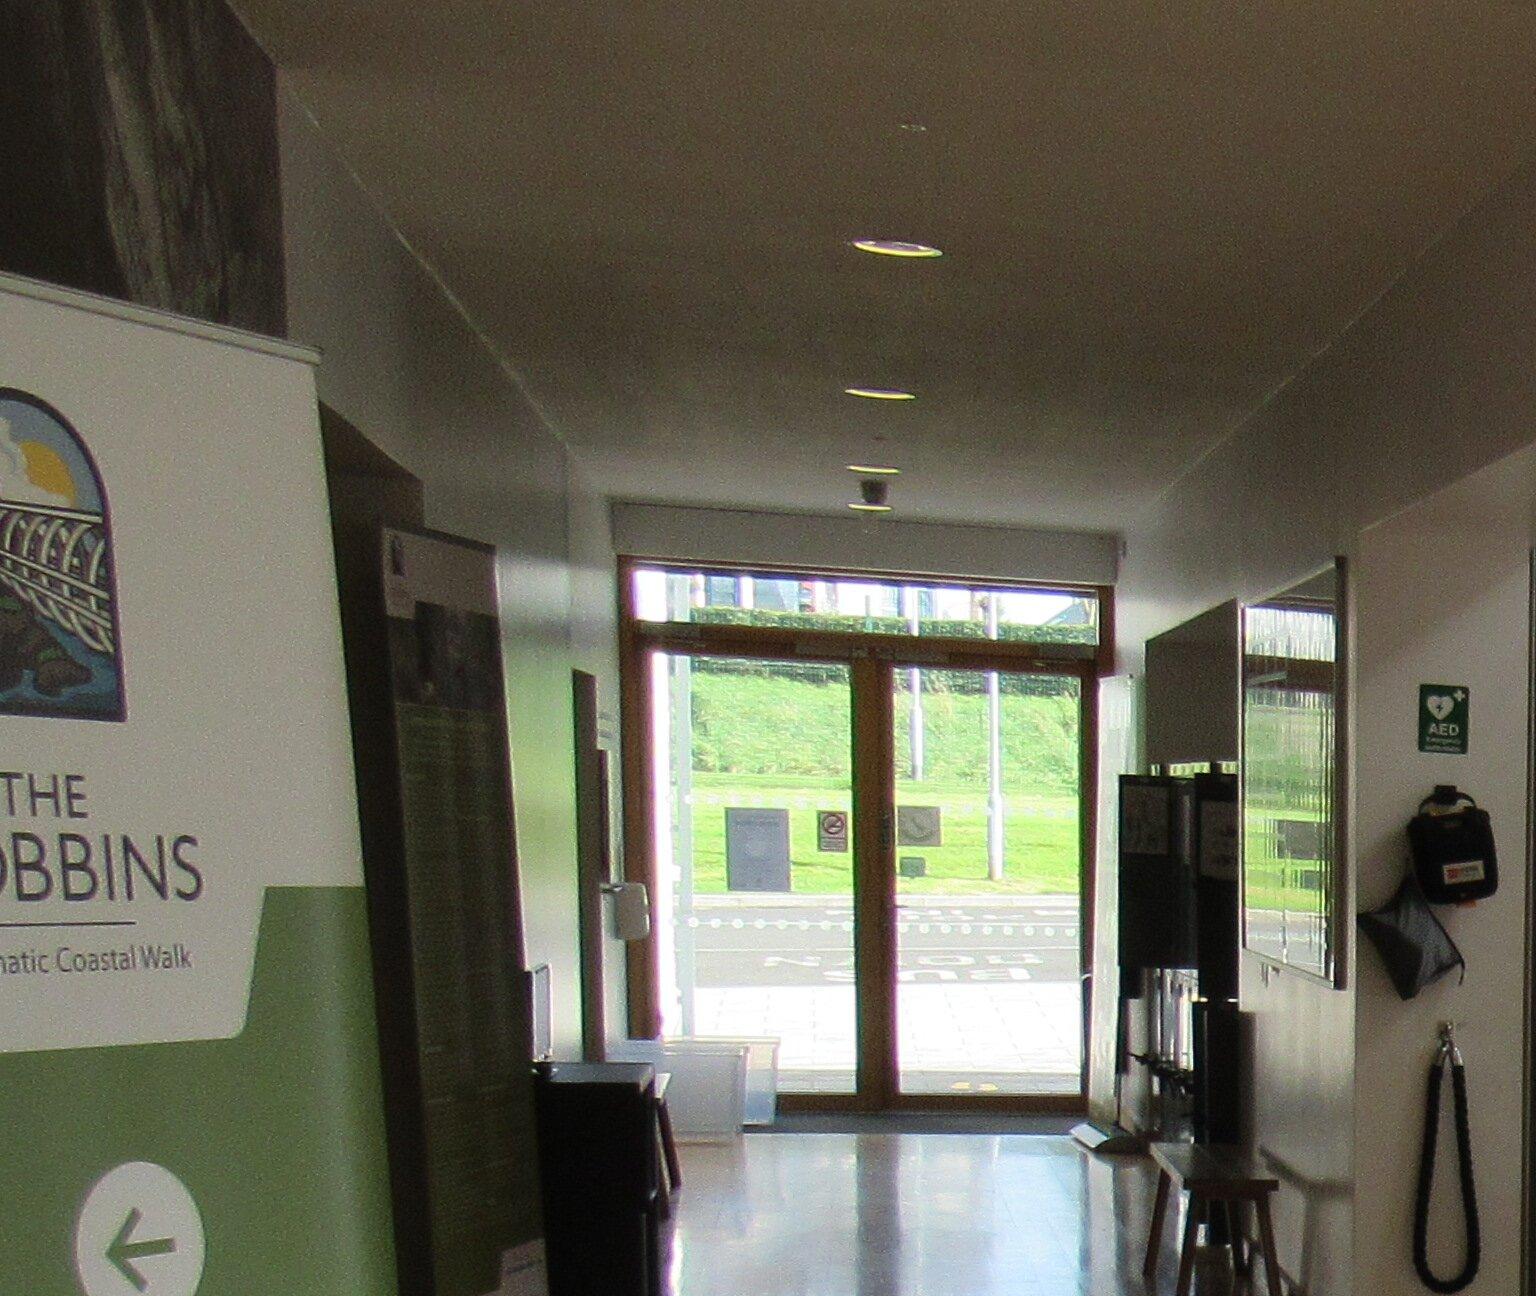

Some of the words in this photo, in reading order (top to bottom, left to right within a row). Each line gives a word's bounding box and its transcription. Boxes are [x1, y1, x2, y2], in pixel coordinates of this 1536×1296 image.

[1429, 723, 1460, 737] AED
[0, 771, 88, 819] THE
[0, 832, 204, 901] BBINS
[56, 944, 136, 973] Coastal
[141, 943, 193, 969] Walk
